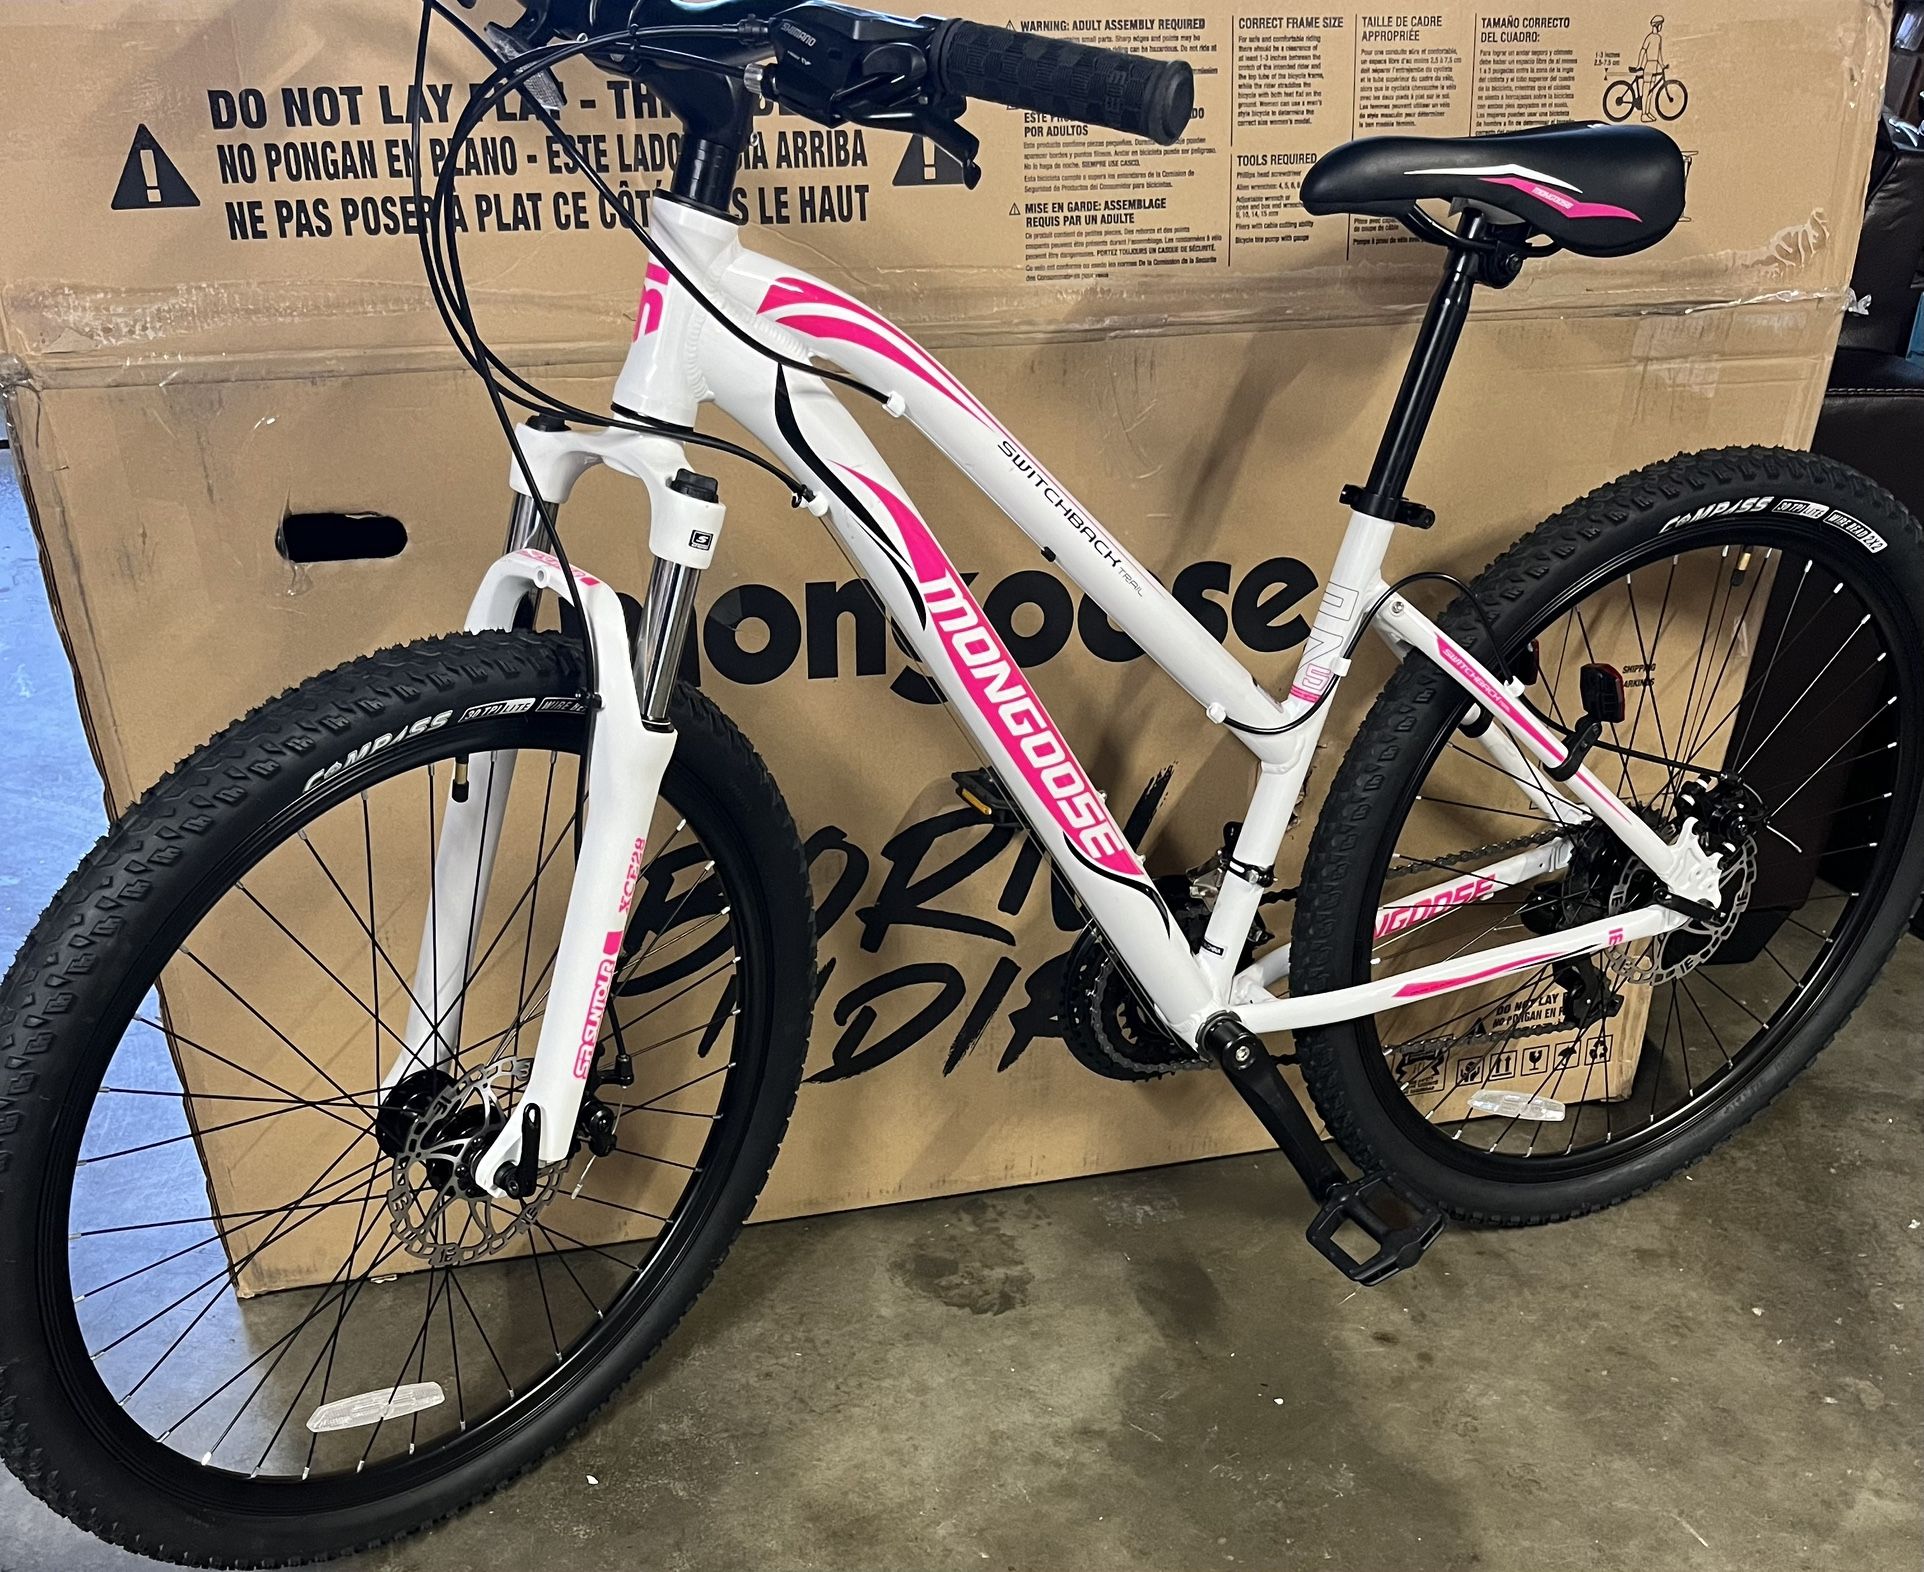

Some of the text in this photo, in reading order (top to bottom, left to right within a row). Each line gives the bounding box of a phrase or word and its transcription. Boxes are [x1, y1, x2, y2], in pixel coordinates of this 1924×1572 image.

[1021, 18, 1205, 31] WARNING: ADULT ASSEMBLY REQUIRED
[1239, 17, 1343, 29] CORRECT FRAME SIZE
[1362, 16, 1442, 27] TAILLE DE CADRE
[1482, 16, 1570, 28] TAMAÑO CORRECTO
[781, 23, 816, 47] SHIMANO
[1362, 28, 1420, 41] APPROPRIÉE
[1481, 32, 1540, 42] DEL CUADRO:
[208, 89, 267, 129] DO
[282, 86, 362, 127] NOT
[379, 84, 452, 124] LAY
[1024, 125, 1088, 137] POR ADULTOS
[217, 143, 257, 184] NO
[264, 140, 378, 182] PONGAN
[385, 139, 422, 178] EN
[546, 133, 607, 175] ESTE
[618, 133, 683, 173] LADO
[776, 129, 868, 169] ARRIBA
[1237, 153, 1317, 166] TOOLS REQUIRED
[225, 200, 268, 240] NE
[275, 198, 332, 238] PAS
[475, 193, 551, 232] PLAT
[553, 191, 589, 231] CE
[759, 187, 790, 225] LE
[800, 185, 869, 223] HAUT
[1025, 198, 1166, 214] MISE EN GARDE: ASSEMBLAGE
[1026, 213, 1134, 227] REQUIS PAR UN ADULTE
[998, 441, 1143, 597] SWITCHBACK TRAIL
[1442, 648, 1502, 705] SWITCHBACK
[541, 701, 572, 710] WIRE
[919, 568, 1124, 859] MONGOOSE
[1374, 874, 1496, 940] NGOOSE
[583, 960, 615, 1044] SUNTOUR
[1538, 993, 1559, 1006] LAY
[1545, 1007, 1556, 1018] EN
